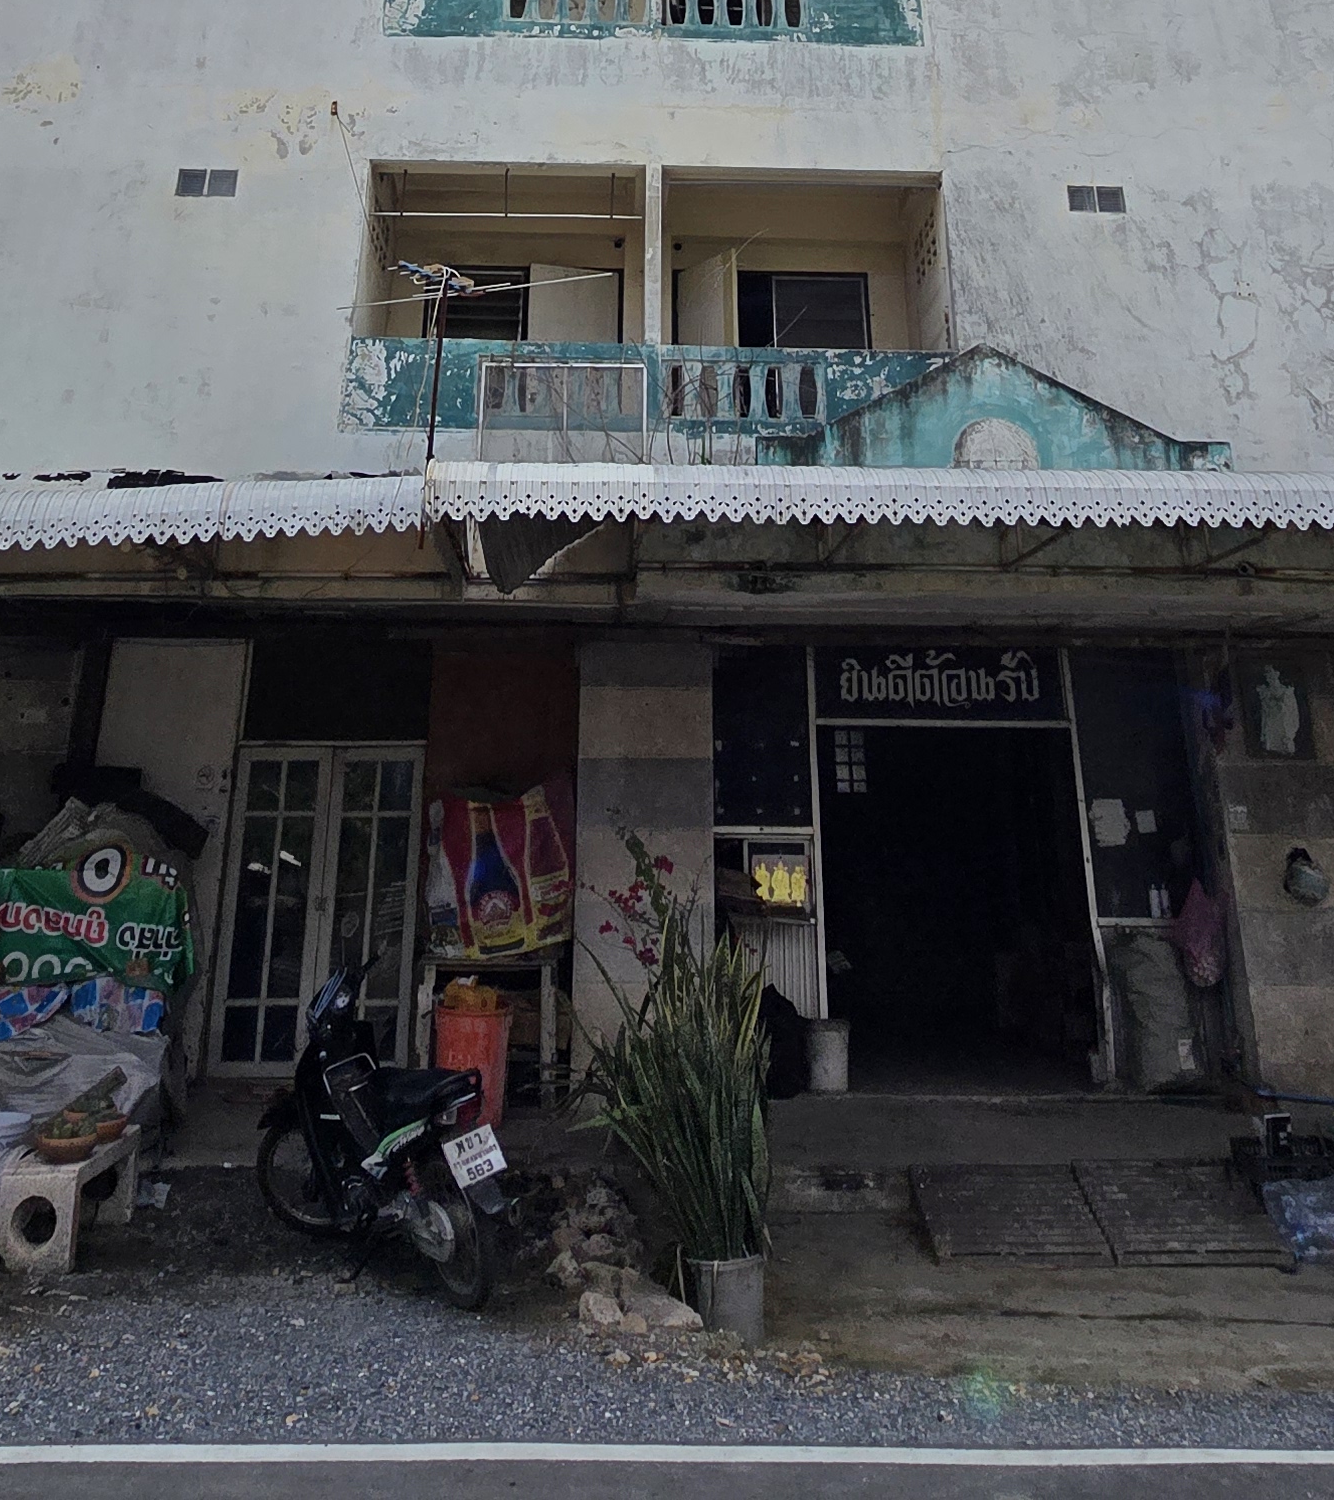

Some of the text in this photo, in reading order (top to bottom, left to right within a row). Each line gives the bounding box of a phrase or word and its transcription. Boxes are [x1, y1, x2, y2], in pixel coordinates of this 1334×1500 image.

[840, 649, 1040, 708] ยินดีต้อนรับ
[466, 1158, 494, 1181] 563
